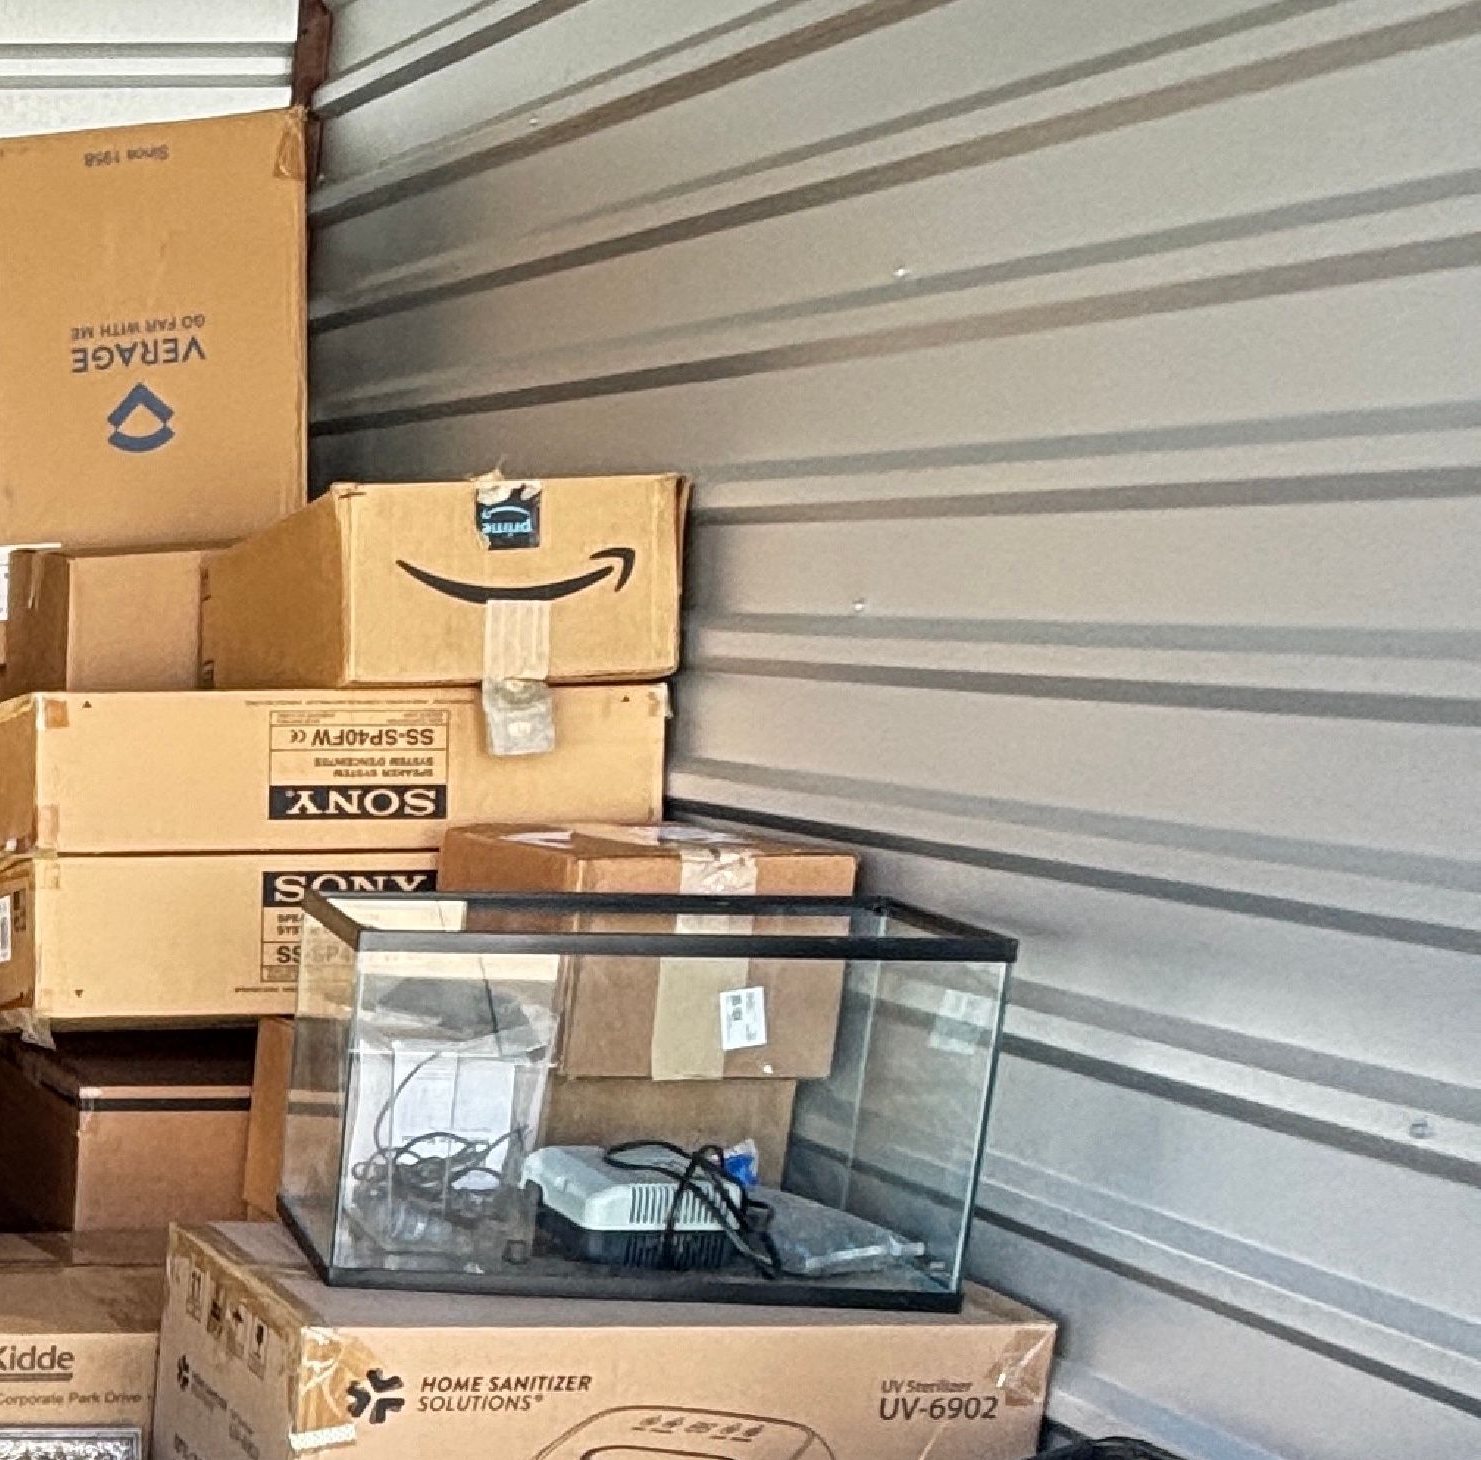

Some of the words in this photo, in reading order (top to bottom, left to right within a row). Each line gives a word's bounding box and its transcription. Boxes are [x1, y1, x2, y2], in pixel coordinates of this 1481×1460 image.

[100, 321, 140, 337] WITH
[144, 316, 176, 332] FAR
[71, 327, 94, 340] ME
[71, 335, 205, 374] VERAGE
[311, 728, 435, 747] SS-SP40FW
[286, 788, 436, 817] SONY
[274, 874, 428, 903] SONY
[420, 1376, 484, 1393] HOME
[487, 1375, 593, 1393] SANITIZER
[880, 1380, 904, 1394] UV
[68, 1391, 101, 1404] Park
[103, 1390, 142, 1404] Drive
[879, 1395, 999, 1420] UV-6902
